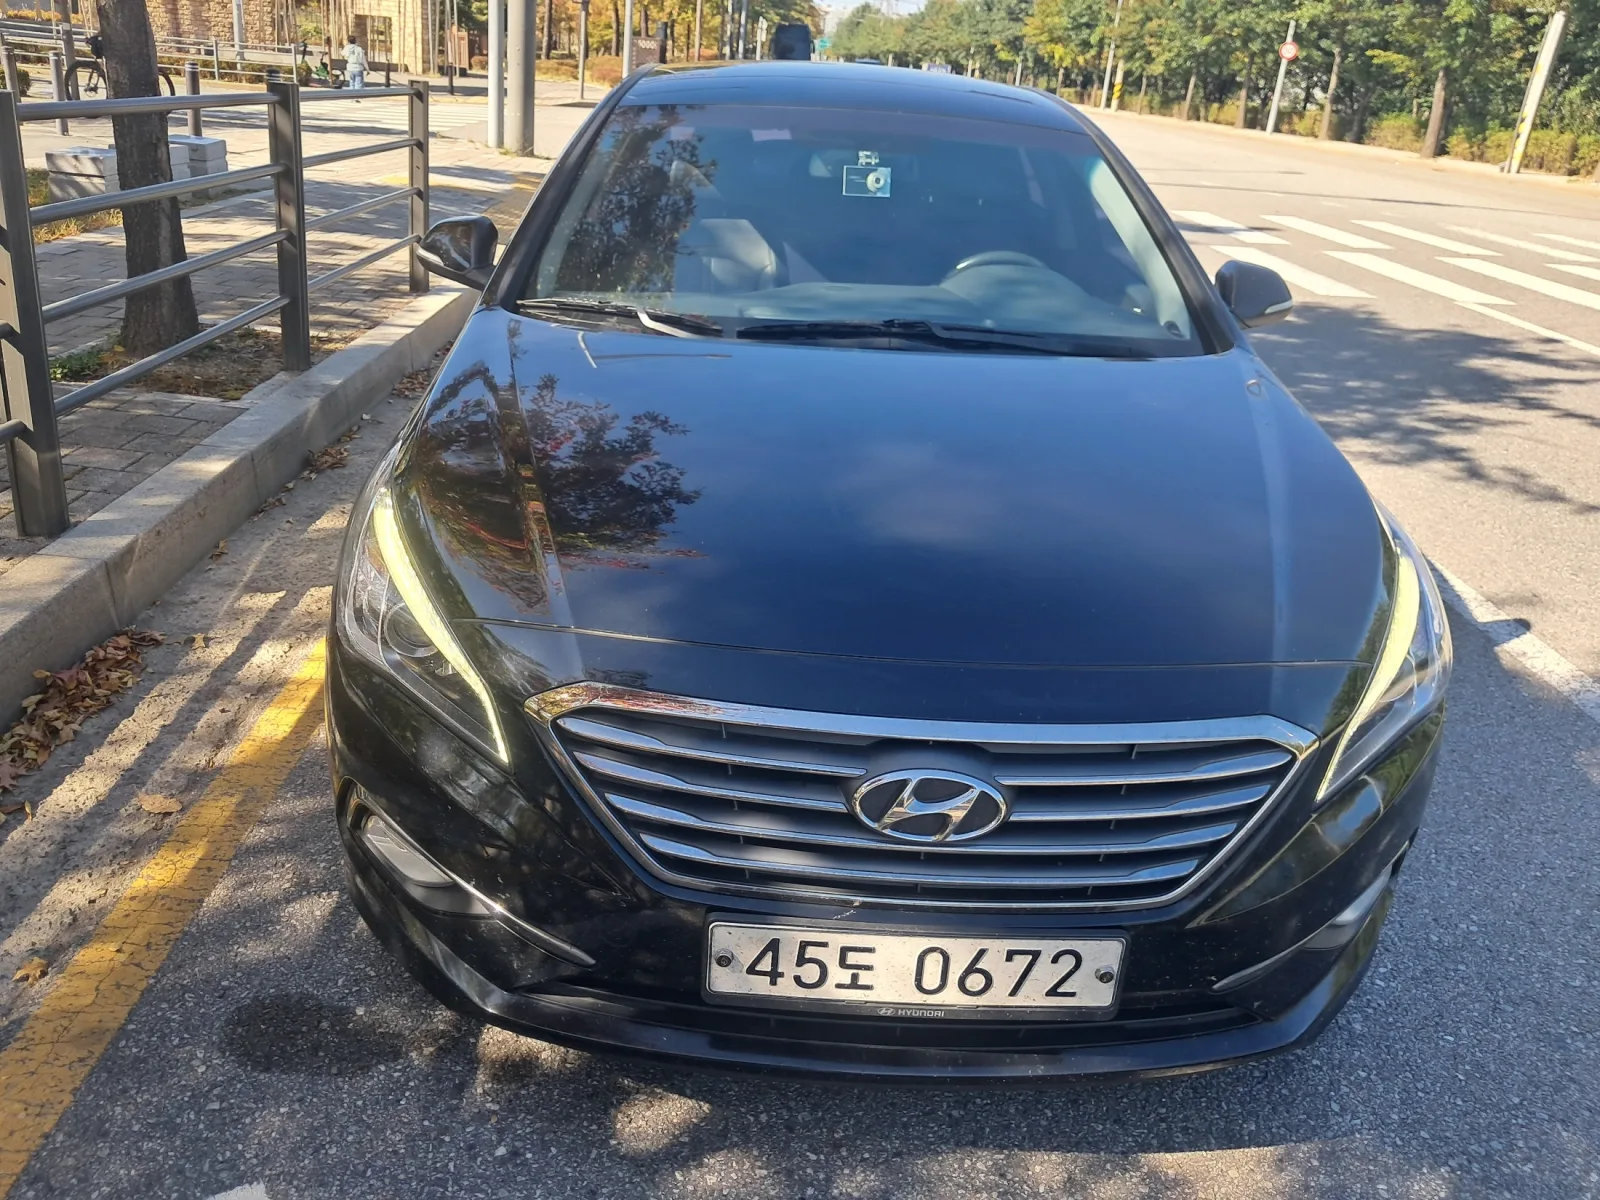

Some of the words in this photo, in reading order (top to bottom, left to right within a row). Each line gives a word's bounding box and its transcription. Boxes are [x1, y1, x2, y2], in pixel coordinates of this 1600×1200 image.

[745, 937, 876, 991] 45도
[914, 945, 1083, 997] 0672
[897, 1008, 945, 1017] HYUNDAI
